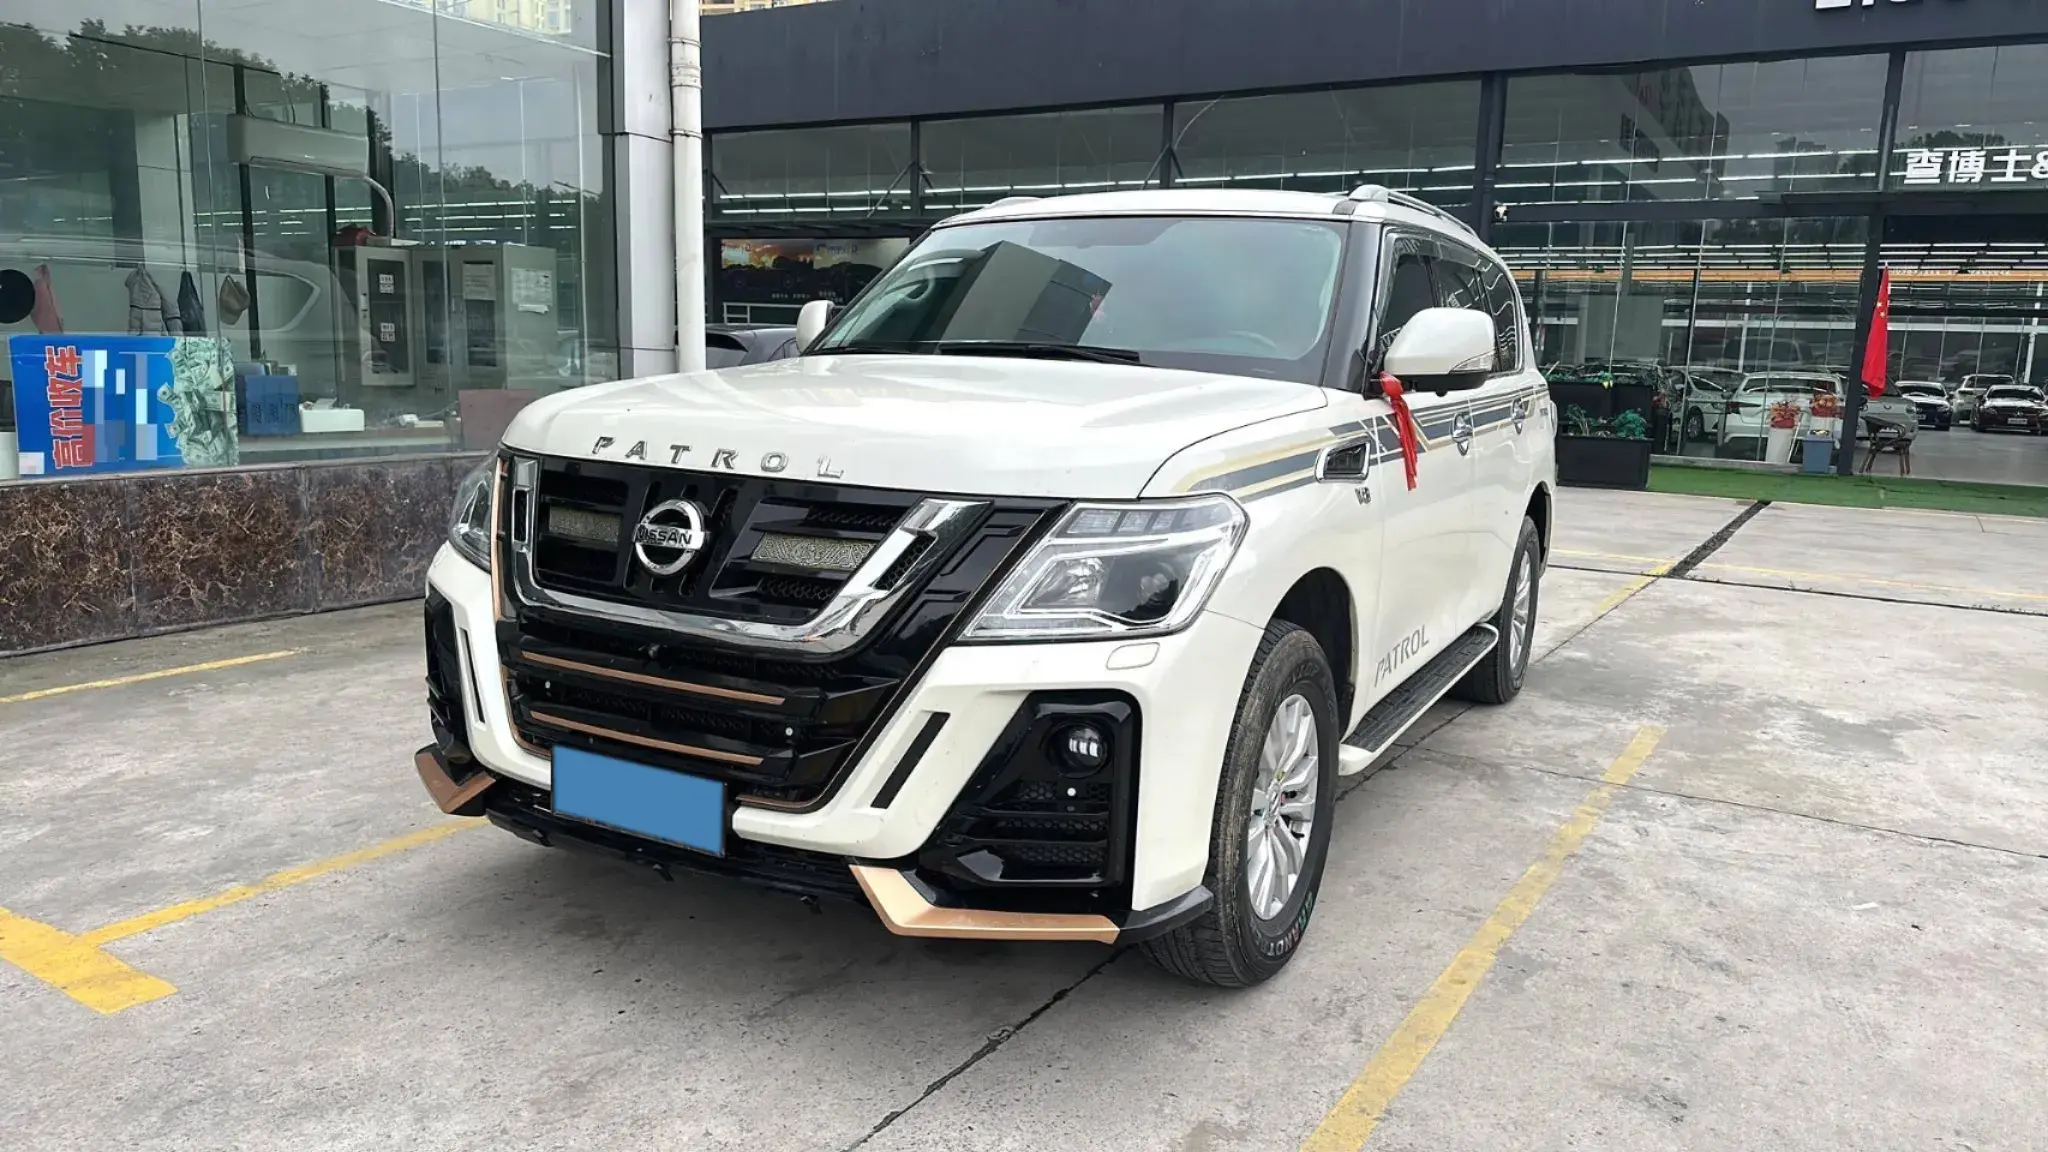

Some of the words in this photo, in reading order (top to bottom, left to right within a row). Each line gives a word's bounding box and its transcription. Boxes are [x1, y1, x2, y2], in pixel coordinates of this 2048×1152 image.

[44, 345, 94, 469] 高价收车
[591, 436, 844, 479] PATROL
[636, 525, 693, 546] NISSAN
[1374, 624, 1430, 688] PATROL
